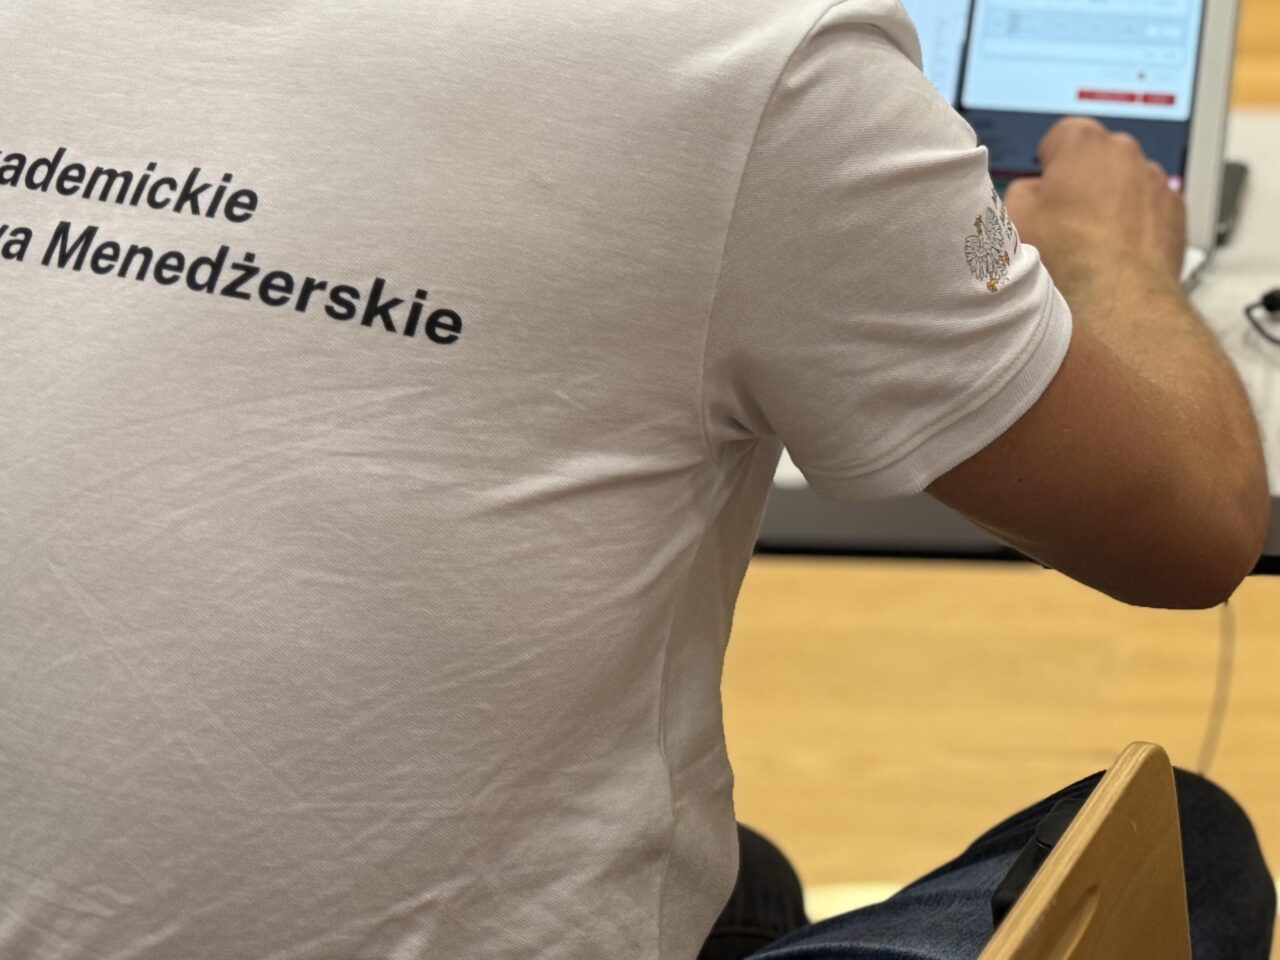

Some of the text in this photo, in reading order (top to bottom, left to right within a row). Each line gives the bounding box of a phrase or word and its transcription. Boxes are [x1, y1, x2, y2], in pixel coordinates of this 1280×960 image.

[0, 146, 259, 224] ademickie
[0, 220, 464, 346] a Menedżerskie
